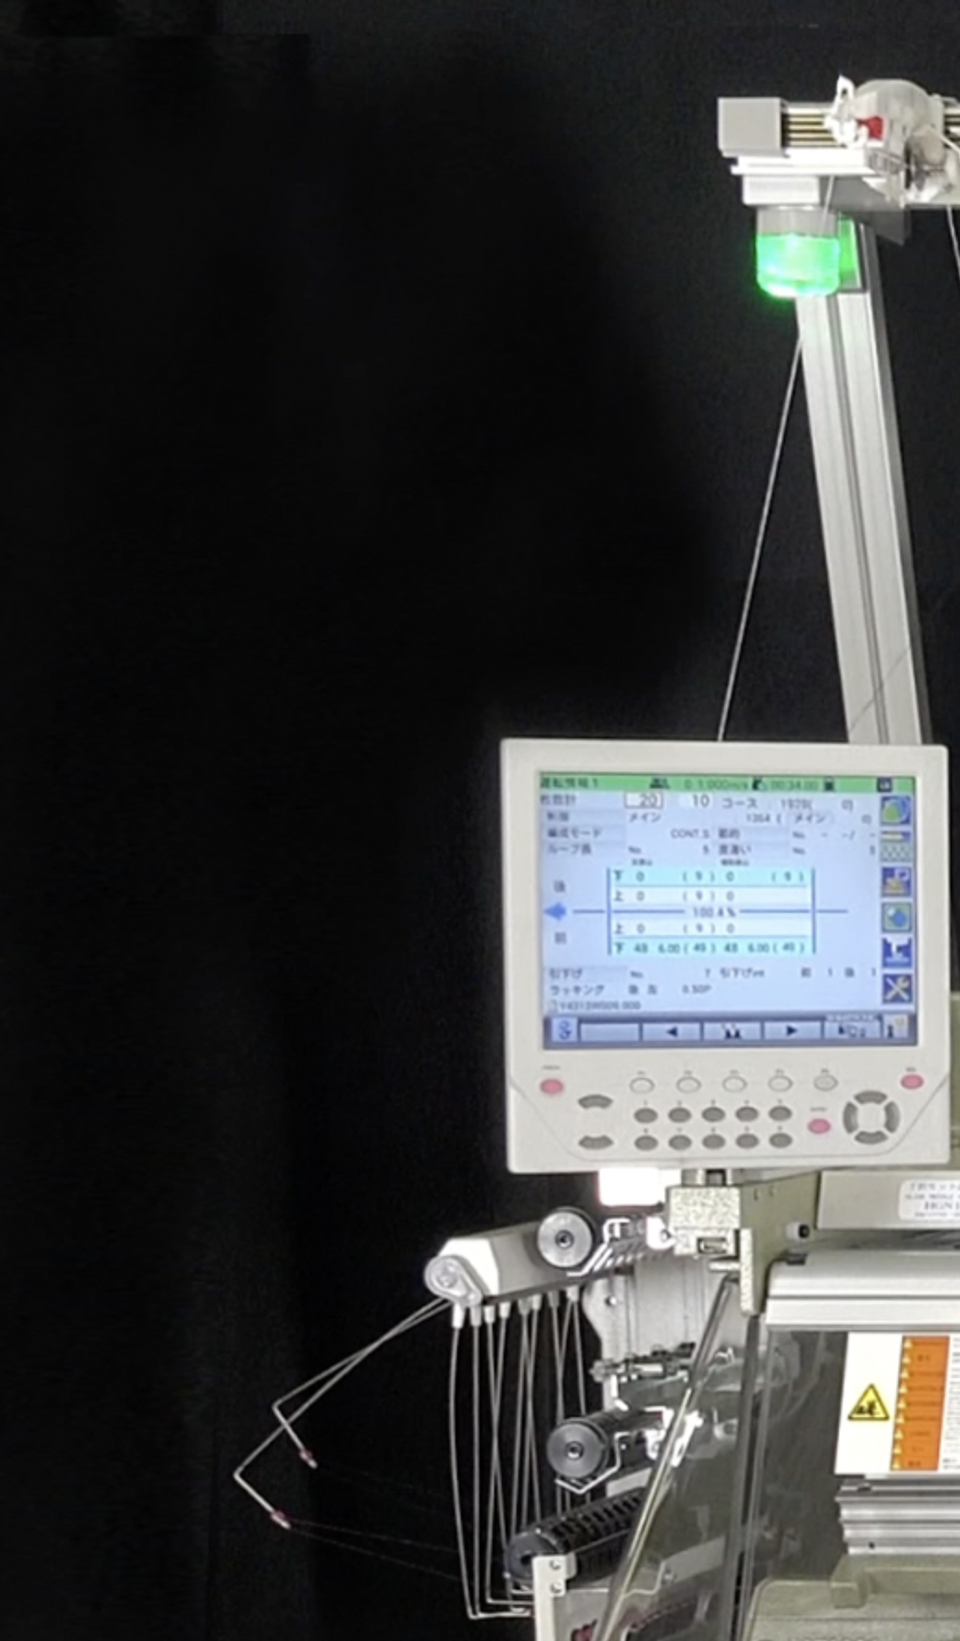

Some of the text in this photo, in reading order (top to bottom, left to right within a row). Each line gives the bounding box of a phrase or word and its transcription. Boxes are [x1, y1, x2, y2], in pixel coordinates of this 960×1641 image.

[639, 793, 710, 808] 20 10
[629, 812, 662, 823] メイン
